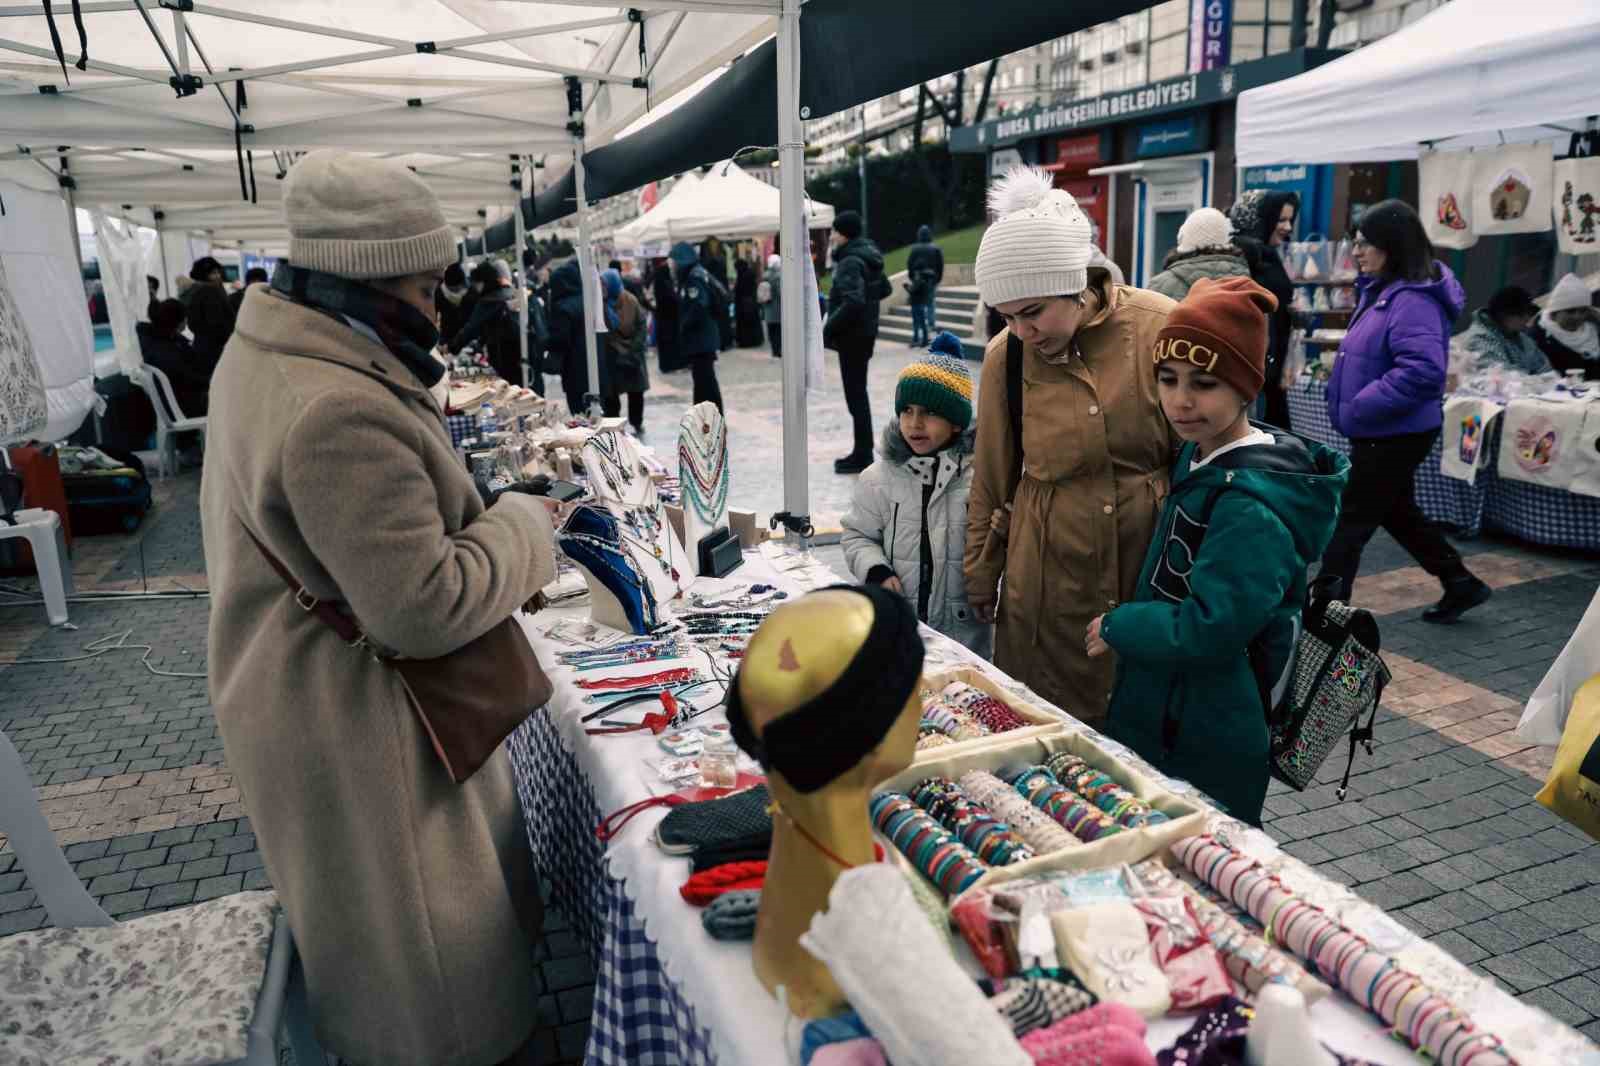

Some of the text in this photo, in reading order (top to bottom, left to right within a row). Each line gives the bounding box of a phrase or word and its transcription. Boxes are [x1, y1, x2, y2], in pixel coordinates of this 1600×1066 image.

[997, 75, 1197, 139] BURSA BÜYÜKŞEHİR BELEDİYESİ
